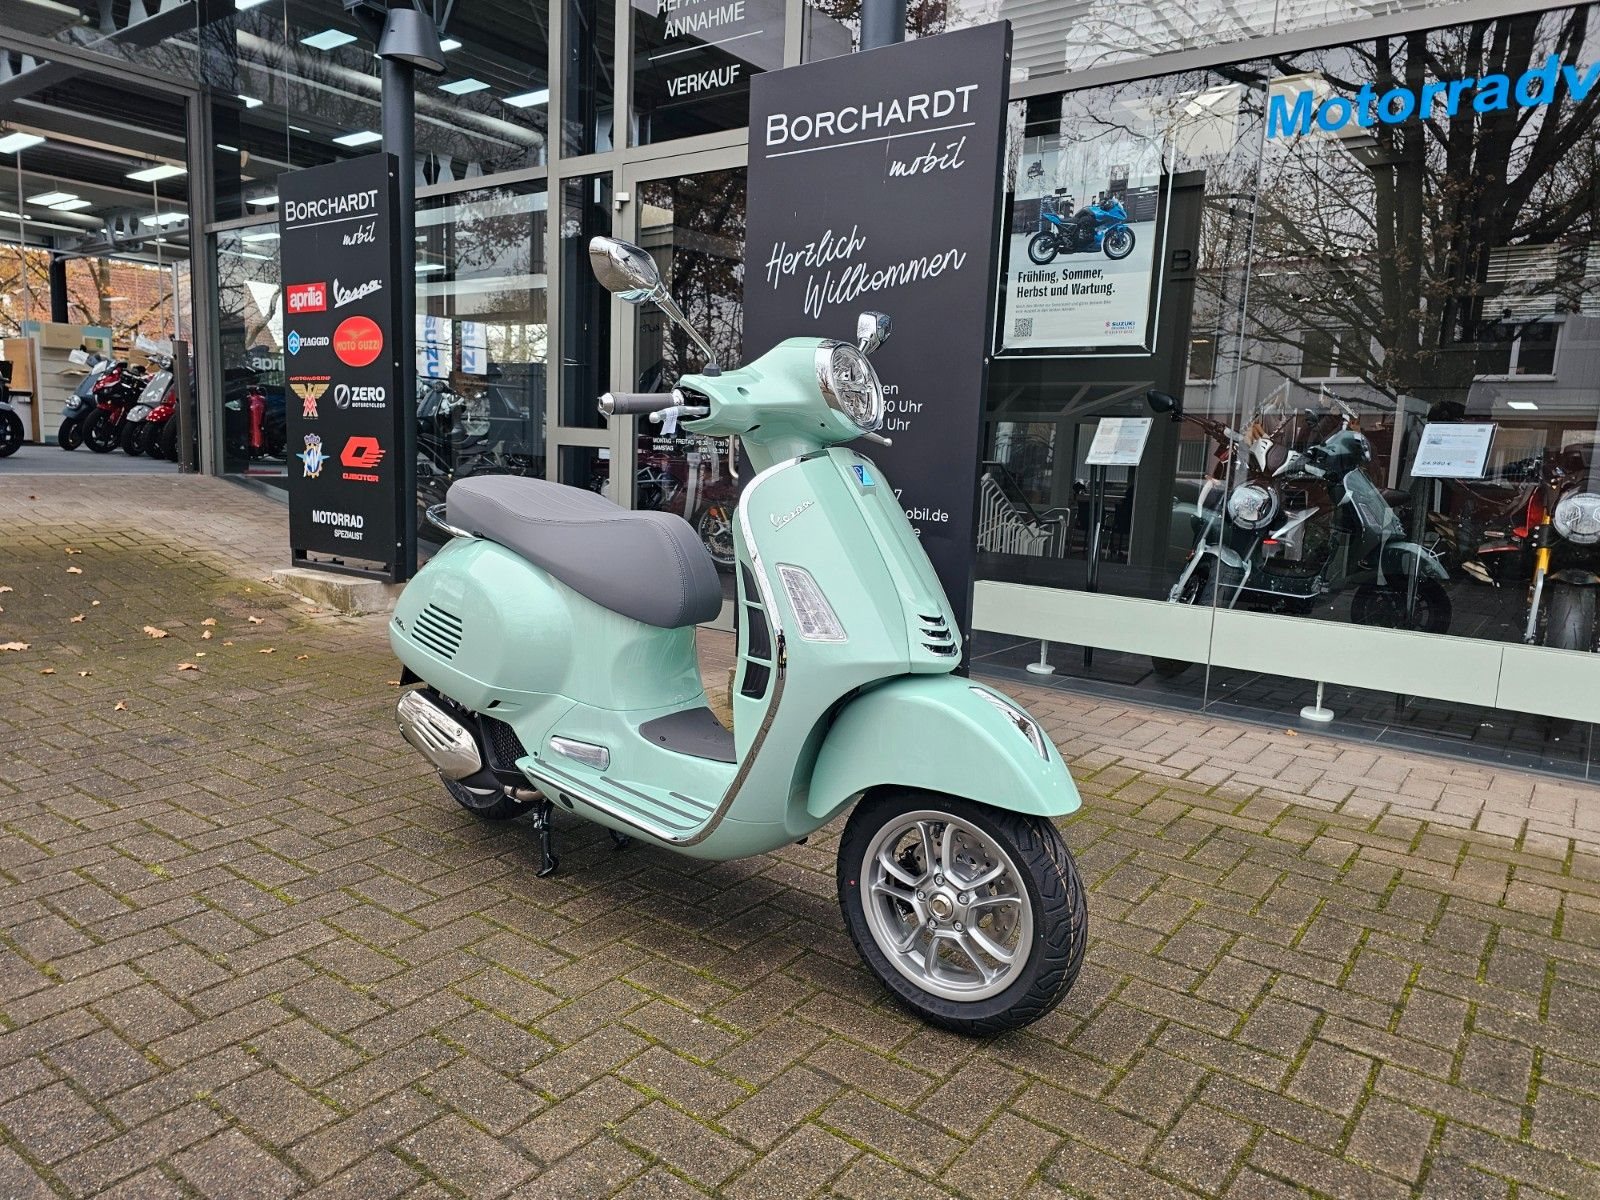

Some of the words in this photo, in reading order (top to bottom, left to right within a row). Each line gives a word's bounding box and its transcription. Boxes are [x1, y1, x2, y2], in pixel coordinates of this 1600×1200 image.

[664, 1, 745, 40] ANNAHME
[666, 64, 740, 97] VERKAUF
[766, 84, 978, 146] BORCHARDT
[889, 136, 966, 177] mobil
[285, 190, 378, 222] BORCHARDT
[342, 221, 376, 246] mobil
[766, 224, 866, 289] Herzlich
[804, 248, 966, 319] Willkommen
[1017, 270, 1059, 284] Frühling,
[1062, 268, 1103, 280] Sommer,
[289, 286, 323, 311] aprilia
[333, 278, 382, 309] Vespa
[1017, 285, 1048, 298] Herbst
[1050, 284, 1068, 296] und
[1071, 283, 1116, 296] Wartung.
[300, 336, 330, 347] PIAGGIO
[336, 341, 356, 351] MOTO
[358, 340, 380, 350] GUZZI
[351, 386, 386, 402] ZERO
[899, 399, 923, 412] Uhr
[887, 418, 910, 431] Uhr
[312, 509, 364, 529] MOTORRAD
[770, 500, 815, 532] Vespa
[334, 529, 363, 541] SPEZIALIST
